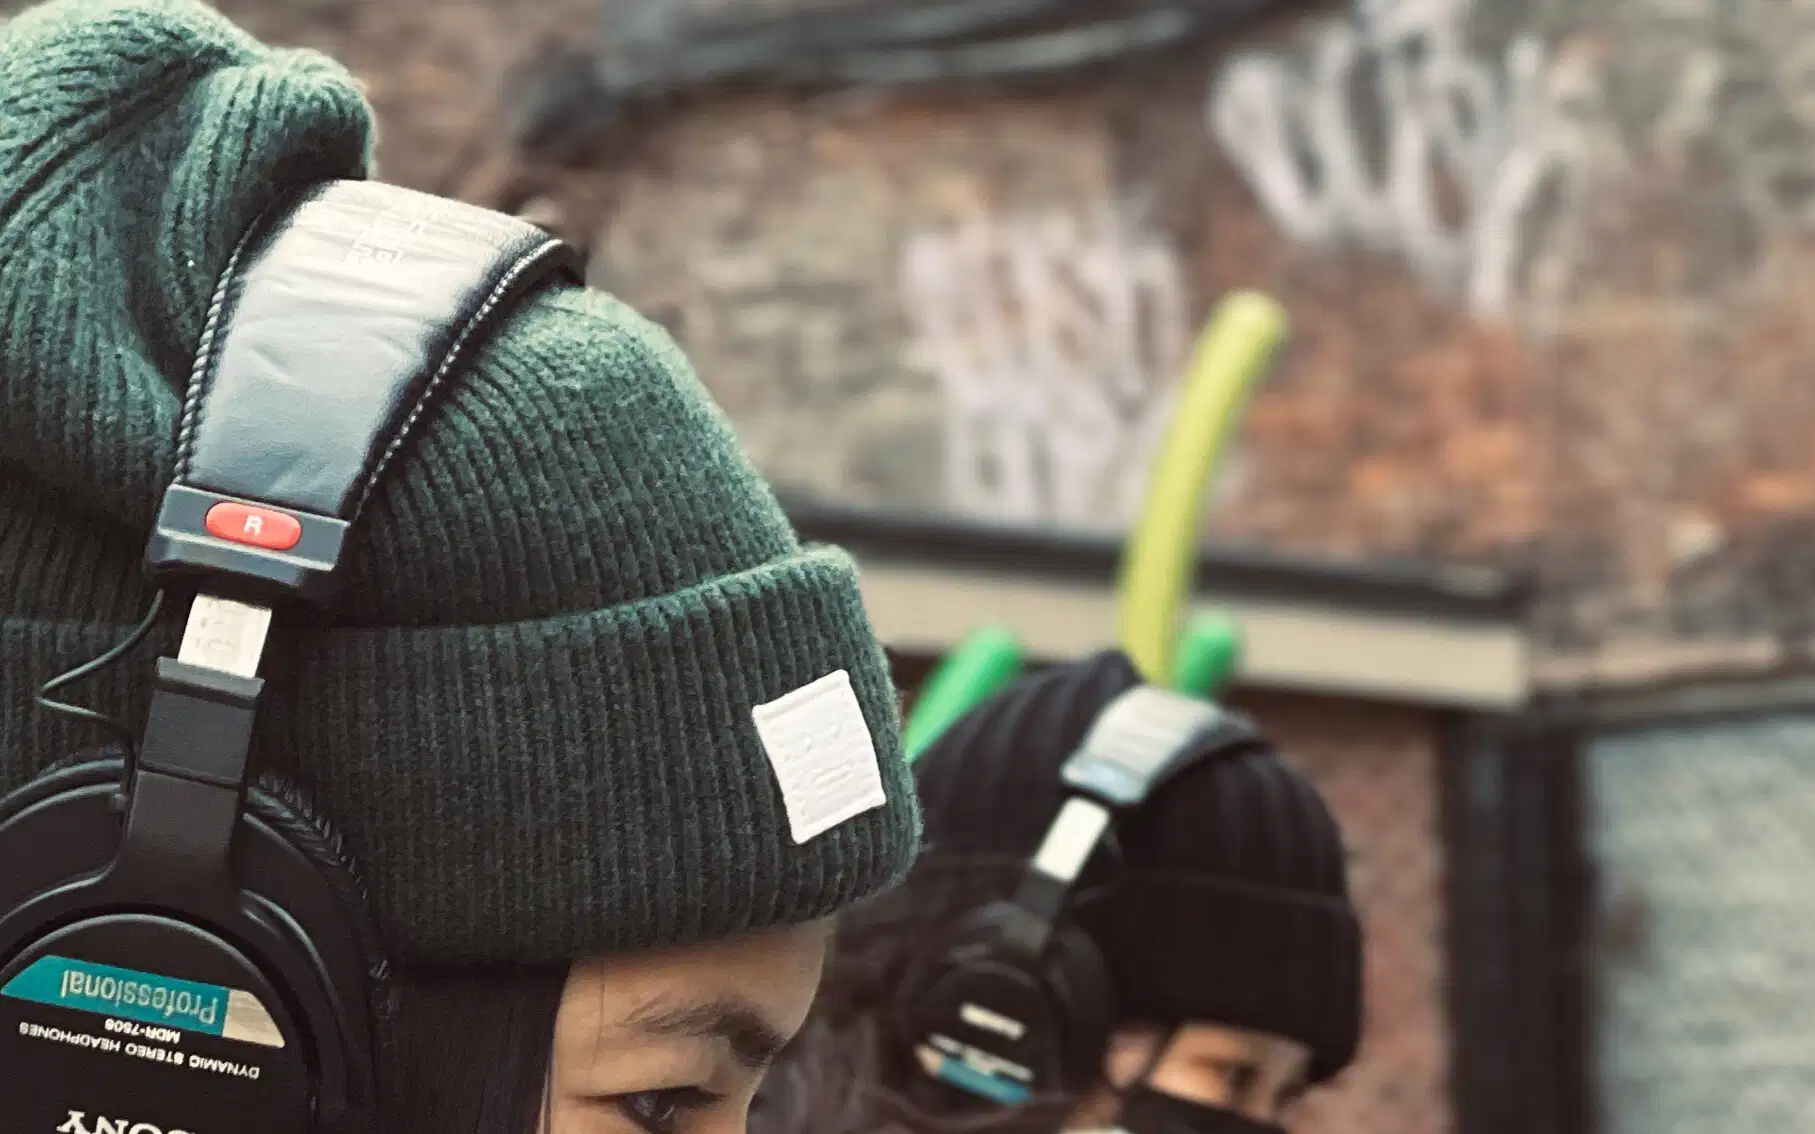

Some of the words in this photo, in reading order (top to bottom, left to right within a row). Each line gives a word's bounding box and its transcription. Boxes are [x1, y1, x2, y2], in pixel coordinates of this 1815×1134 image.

[244, 514, 263, 536] R
[60, 968, 219, 1026] Professional
[18, 1021, 121, 1053] HEADPHONES
[125, 1044, 184, 1066] STEREO
[190, 1054, 261, 1080] DYNAMIC
